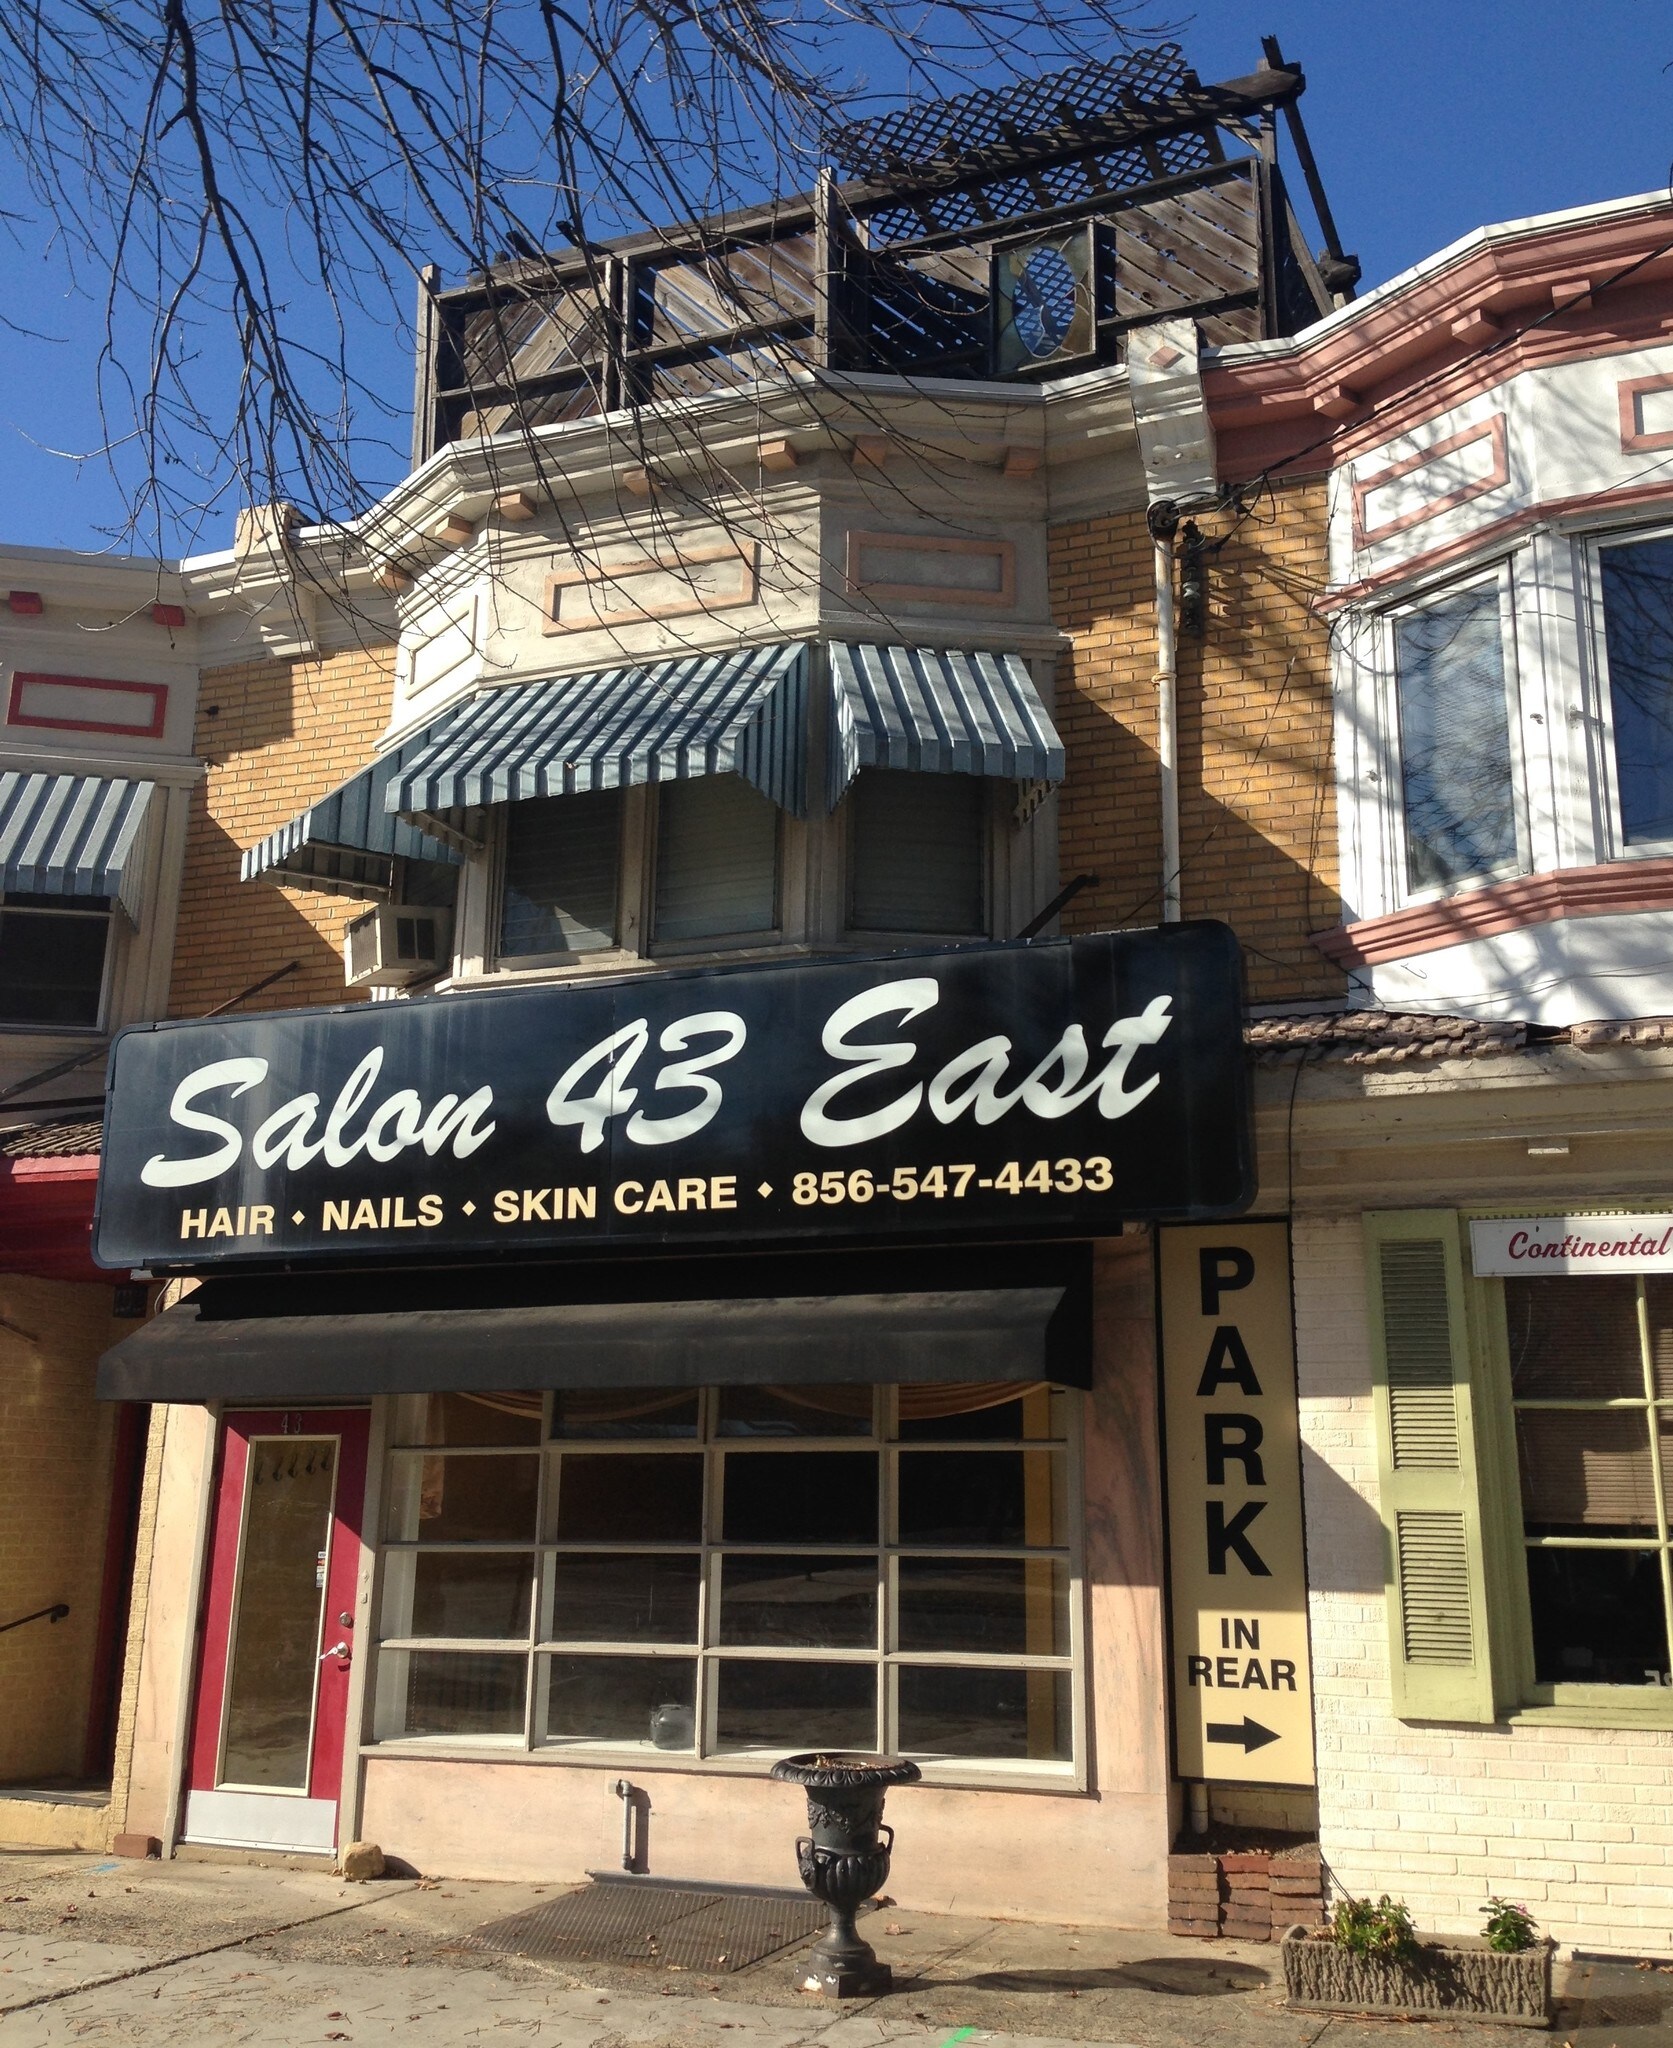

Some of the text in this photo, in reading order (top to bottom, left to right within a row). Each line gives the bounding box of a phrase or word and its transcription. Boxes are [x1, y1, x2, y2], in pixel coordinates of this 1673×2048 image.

[140, 977, 1173, 1188] Salon 43 East
[180, 1156, 1114, 1239] HAIR NAILS SKIN CARE 856-547-4433
[1509, 1226, 1673, 1259] Continental
[280, 1413, 303, 1435] 43
[1195, 1245, 1273, 1577] PARK
[1220, 1617, 1261, 1651] IN
[1187, 1655, 1297, 1692] REAR
